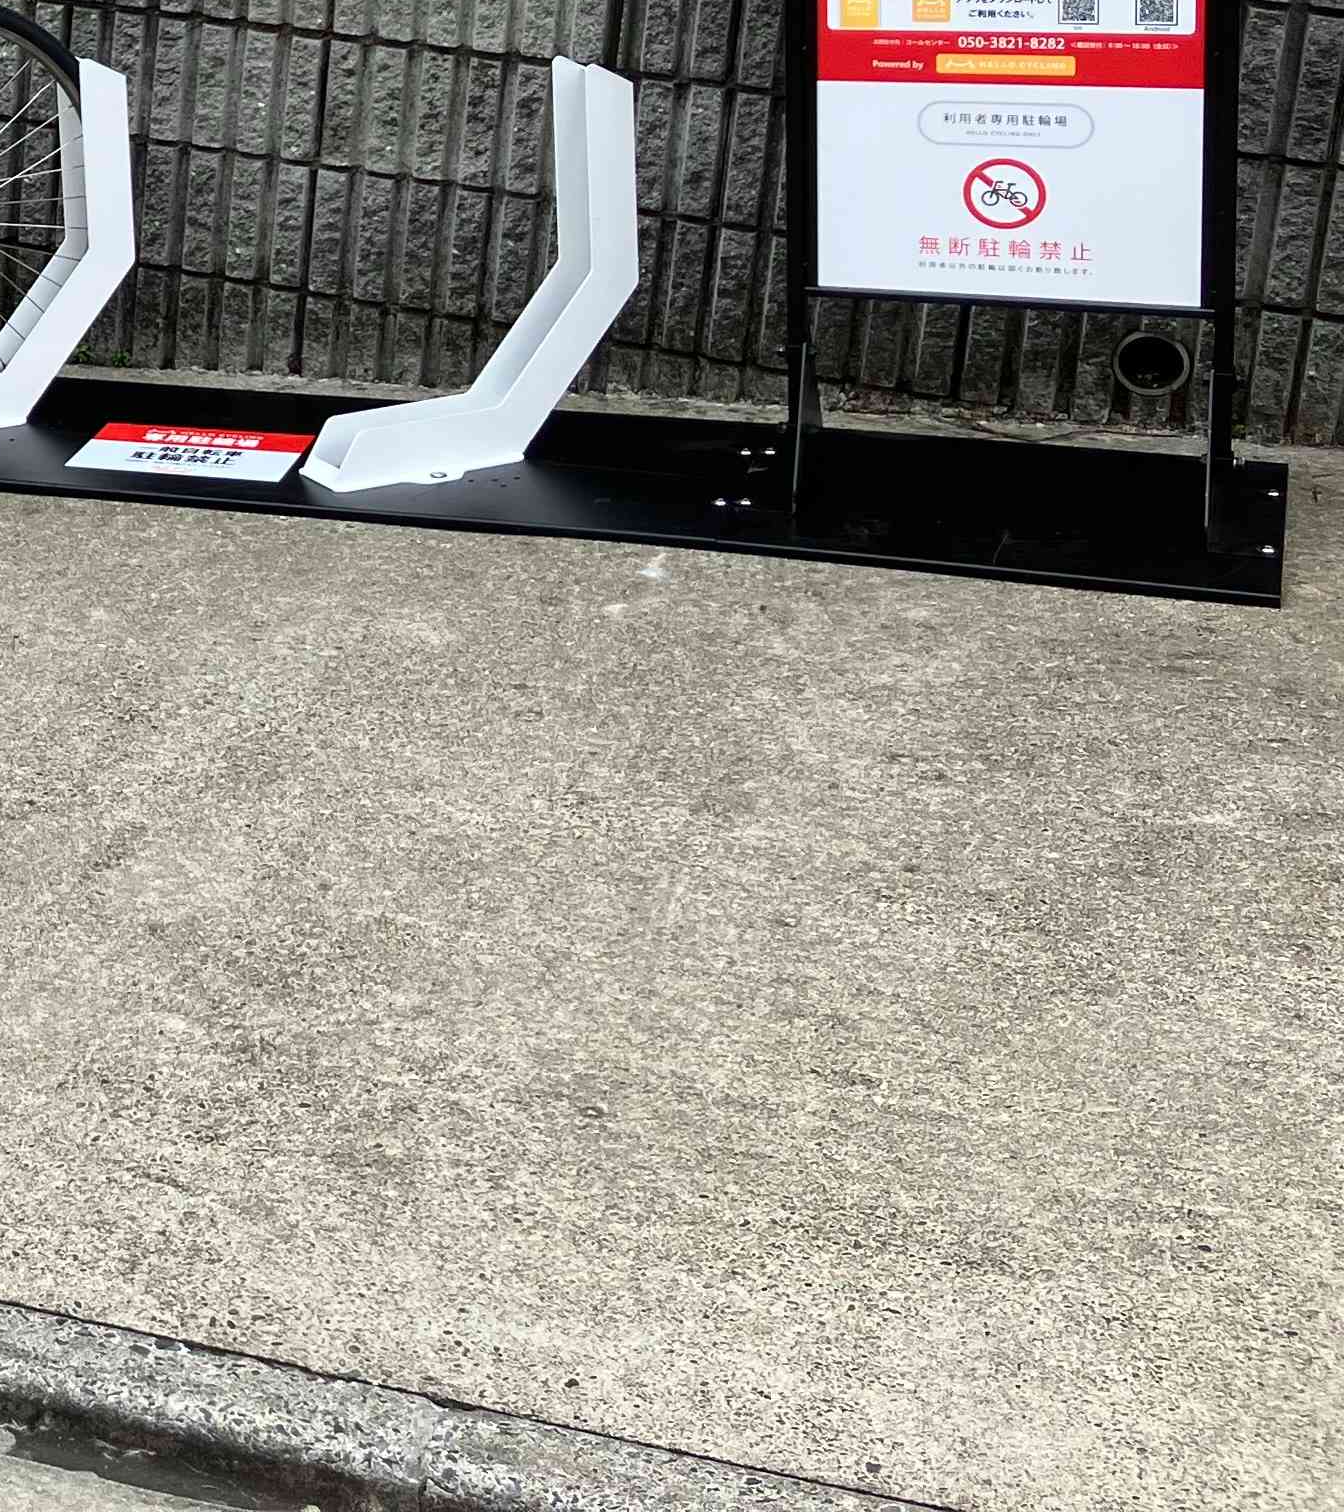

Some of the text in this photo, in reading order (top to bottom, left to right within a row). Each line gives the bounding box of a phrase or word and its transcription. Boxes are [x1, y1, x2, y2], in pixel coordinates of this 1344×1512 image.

[957, 35, 1066, 50] 050-3821-8282
[872, 59, 925, 71] Powered by
[944, 112, 1068, 128] 利用者専用駐輪場
[918, 234, 1094, 262] 無断駐輪禁止
[129, 450, 237, 466] 駐輪禁止
